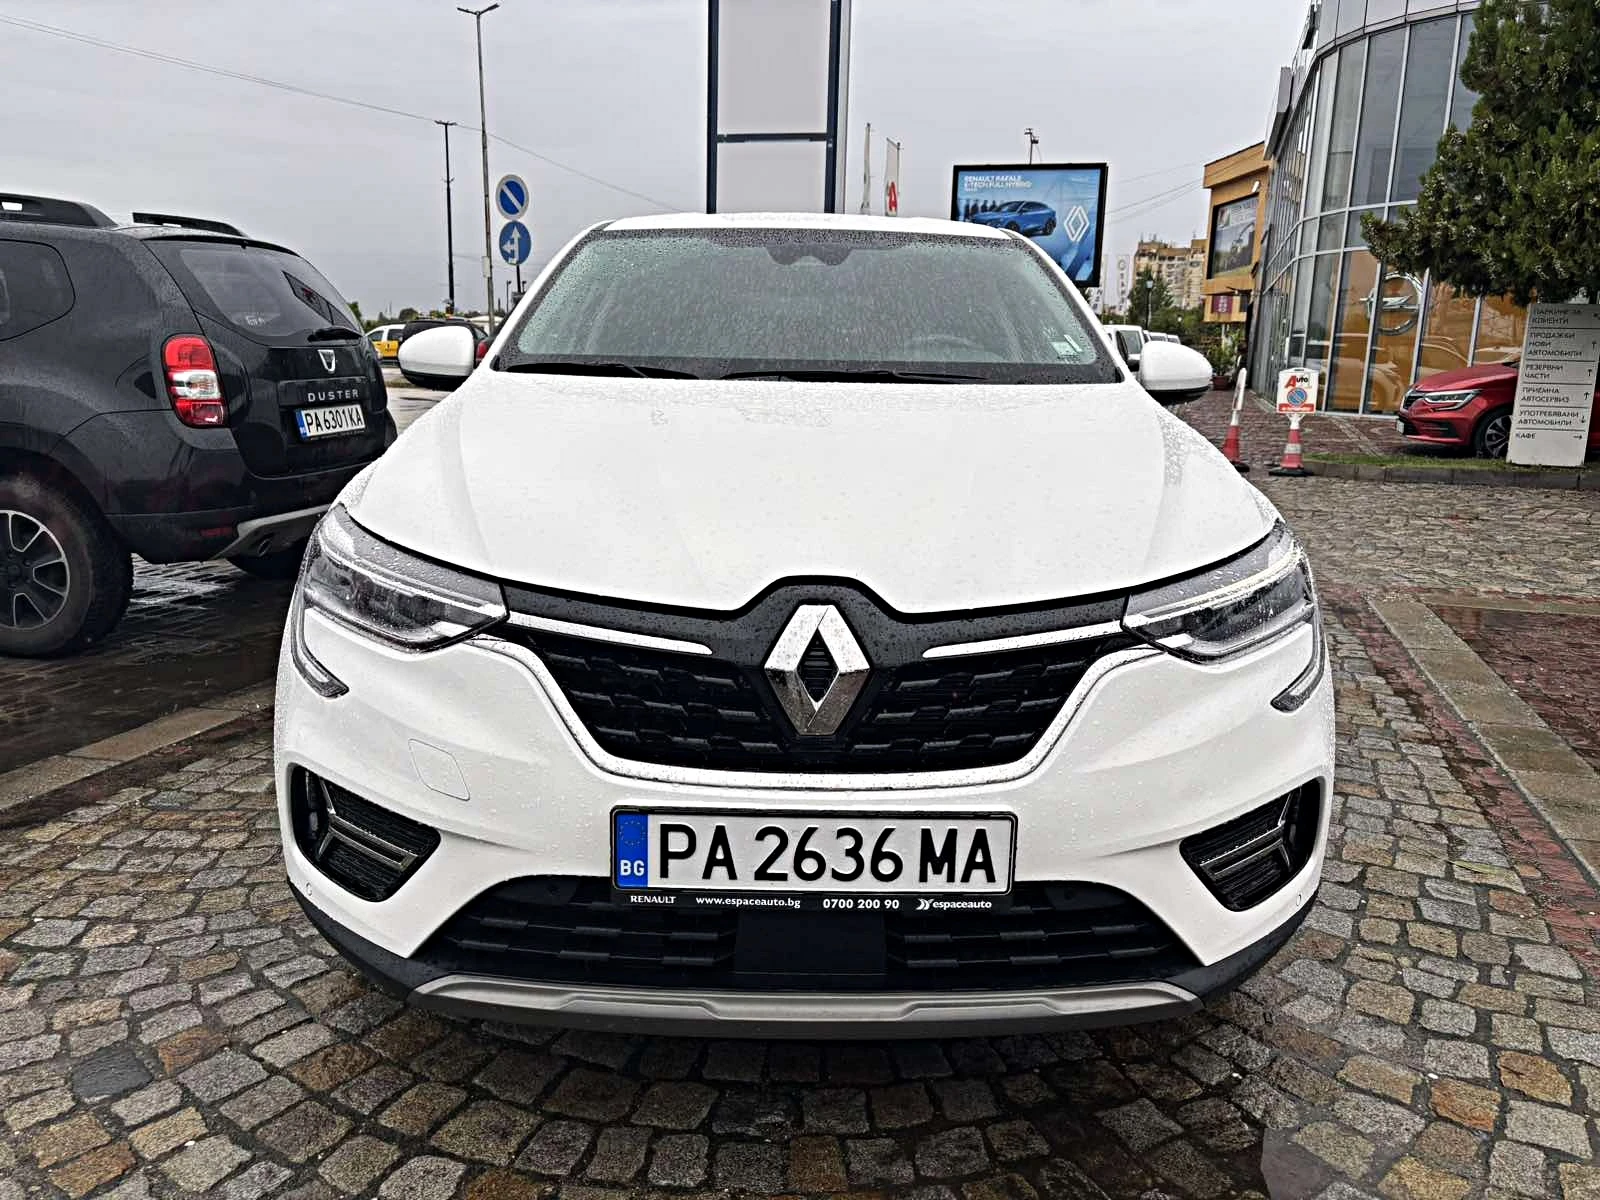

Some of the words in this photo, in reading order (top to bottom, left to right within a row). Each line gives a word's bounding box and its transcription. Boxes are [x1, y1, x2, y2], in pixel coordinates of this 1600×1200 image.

[1529, 332, 1575, 340] ПРОДАЖБИ
[1527, 349, 1582, 357] АВТОМОБИЛИ
[1522, 386, 1560, 394] ПРИЕМНА
[308, 389, 358, 402] DUSTER
[1517, 418, 1572, 426] АВТОМОБИЛИ
[660, 823, 738, 880] PA
[754, 825, 904, 882] 2636
[919, 828, 996, 882] MA
[620, 859, 645, 877] BG
[630, 895, 677, 904] RENAULT
[696, 896, 801, 908] www.espaceauto.bg
[823, 899, 854, 909] 0700
[857, 899, 881, 909] 200
[884, 899, 900, 909] 90
[932, 900, 992, 910] espaceauto
